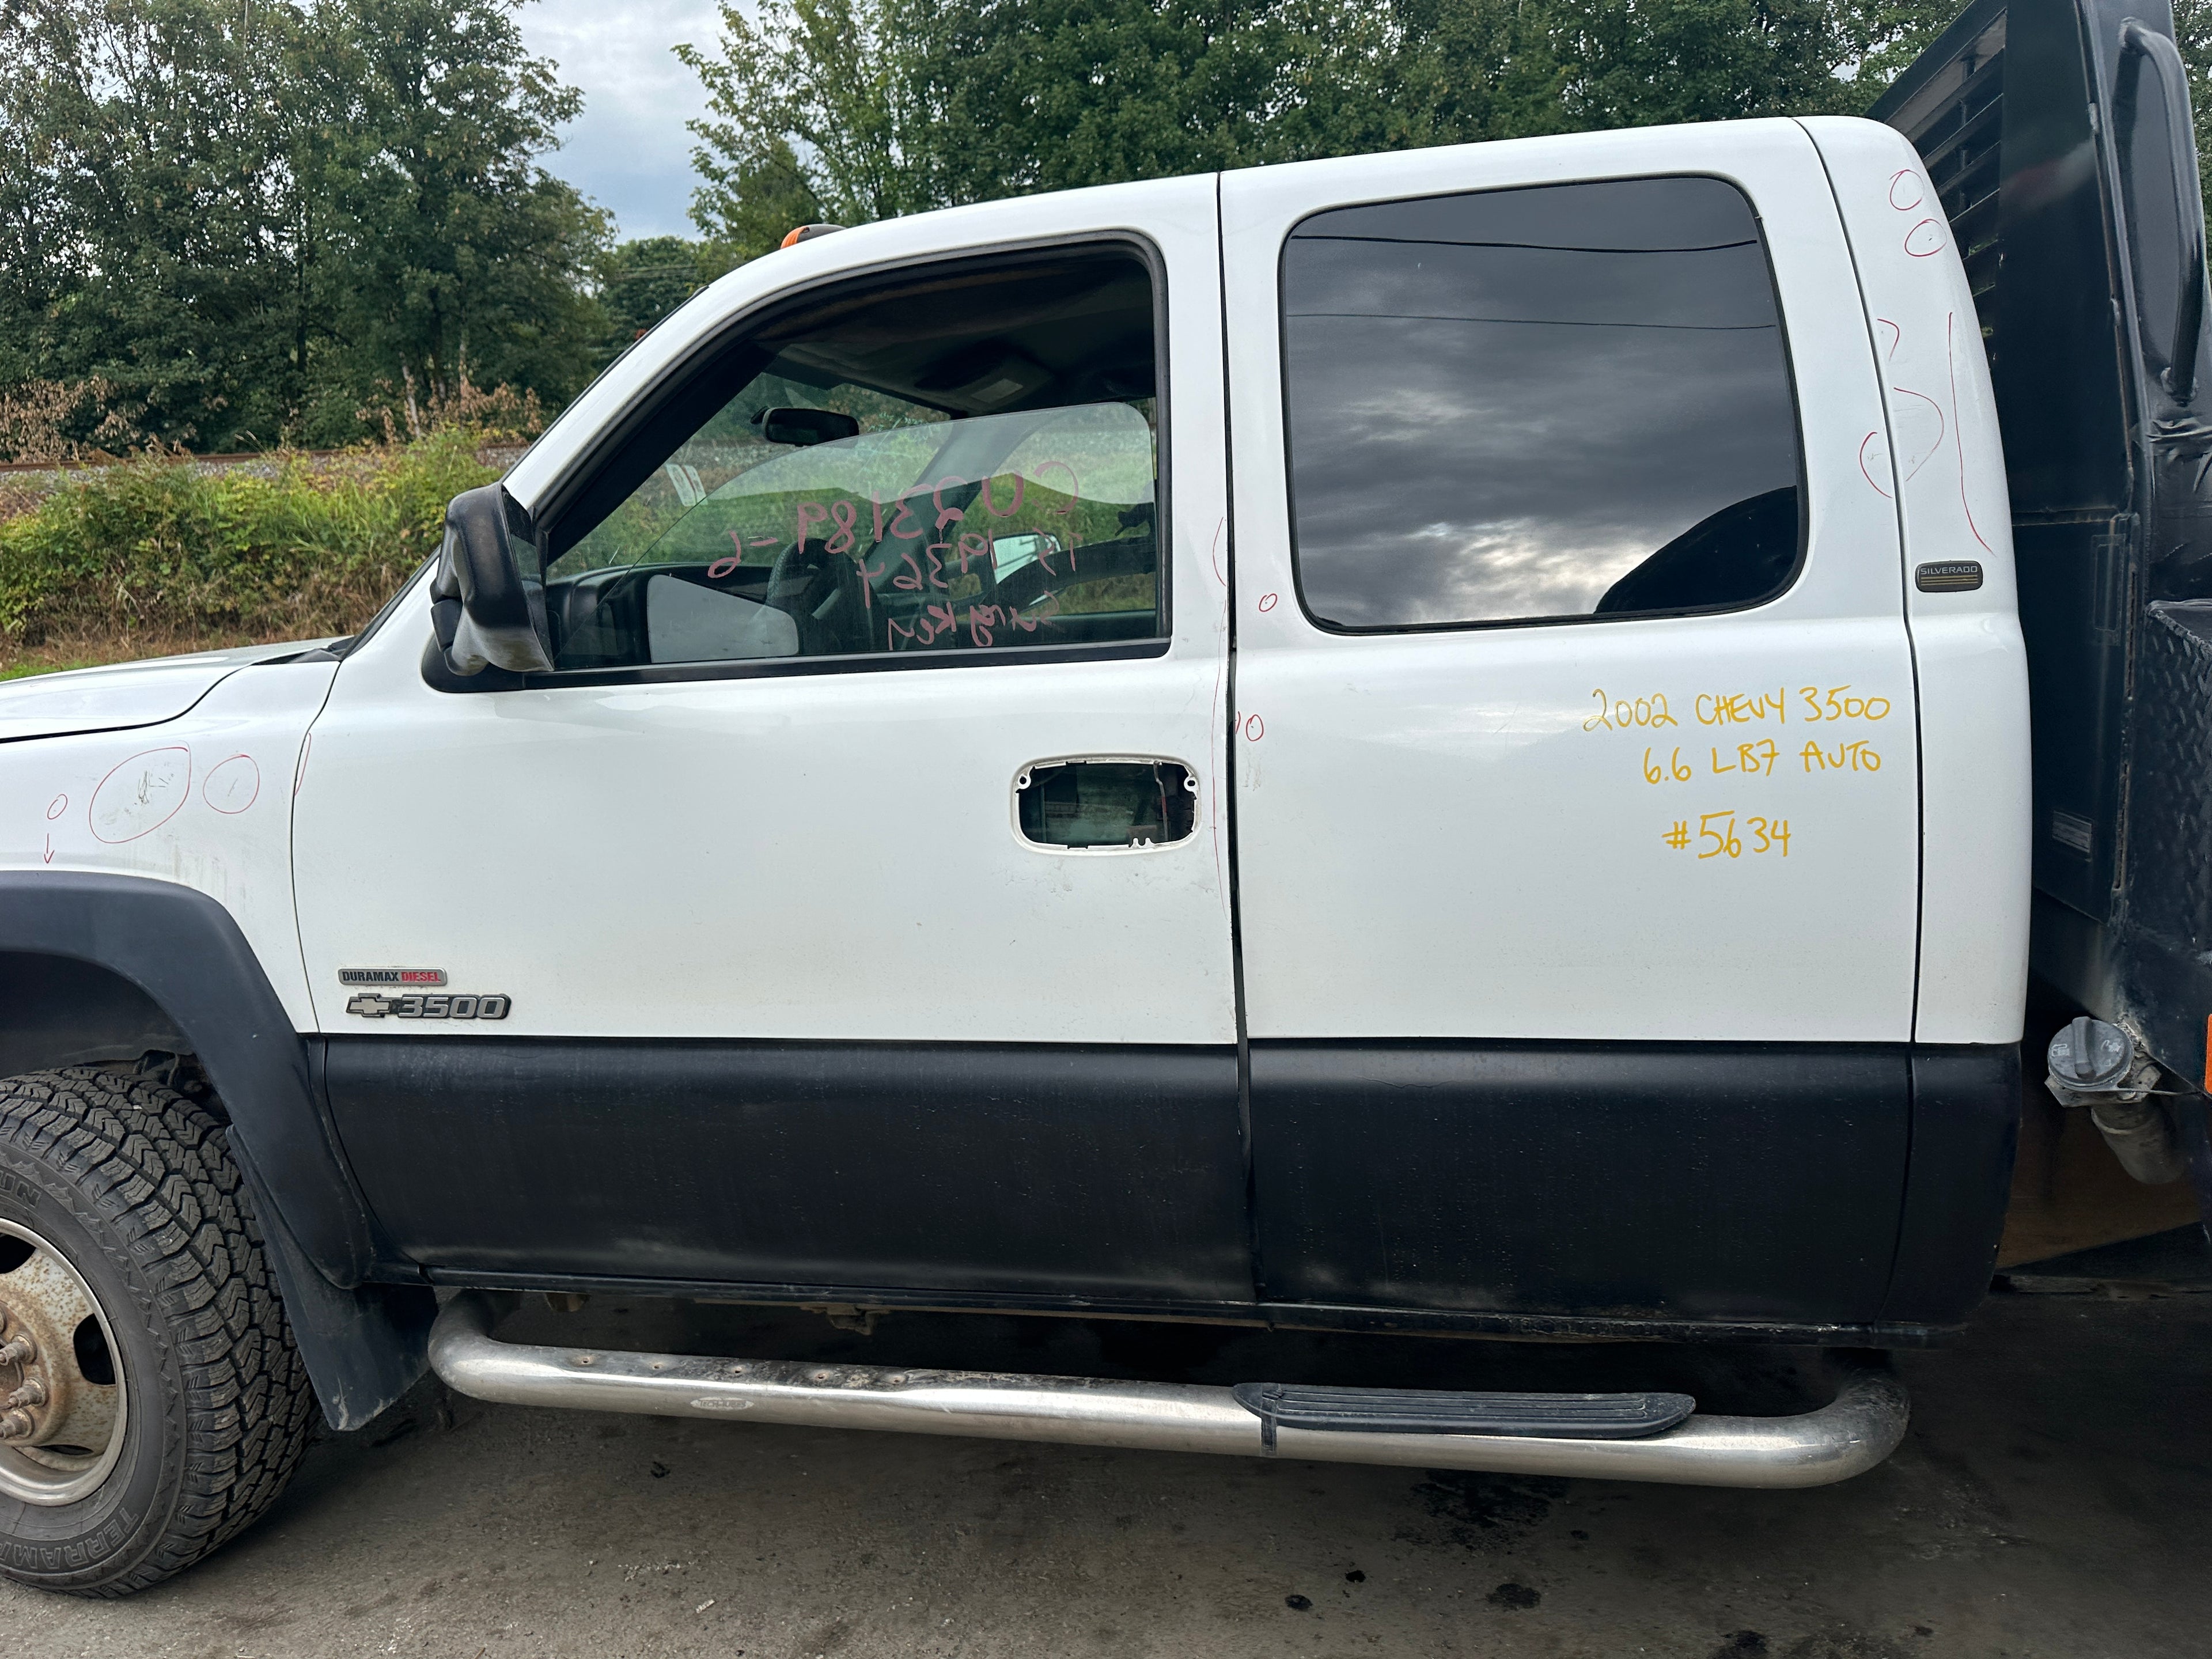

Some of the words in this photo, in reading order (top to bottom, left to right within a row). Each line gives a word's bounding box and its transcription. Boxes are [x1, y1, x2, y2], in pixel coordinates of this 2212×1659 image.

[1921, 566, 1978, 575] SILVERADO
[1582, 688, 1678, 732] 2002
[1695, 687, 1785, 726] CHEVY
[1798, 684, 1891, 722] 3500
[1643, 747, 1692, 785] 6.6
[1711, 738, 1780, 777] LB7
[1799, 740, 1881, 772] AUTO
[1661, 809, 1791, 859] #5634
[342, 971, 399, 982] DURAMAX
[401, 971, 441, 983] DIESEL
[397, 995, 507, 1018] 3500
